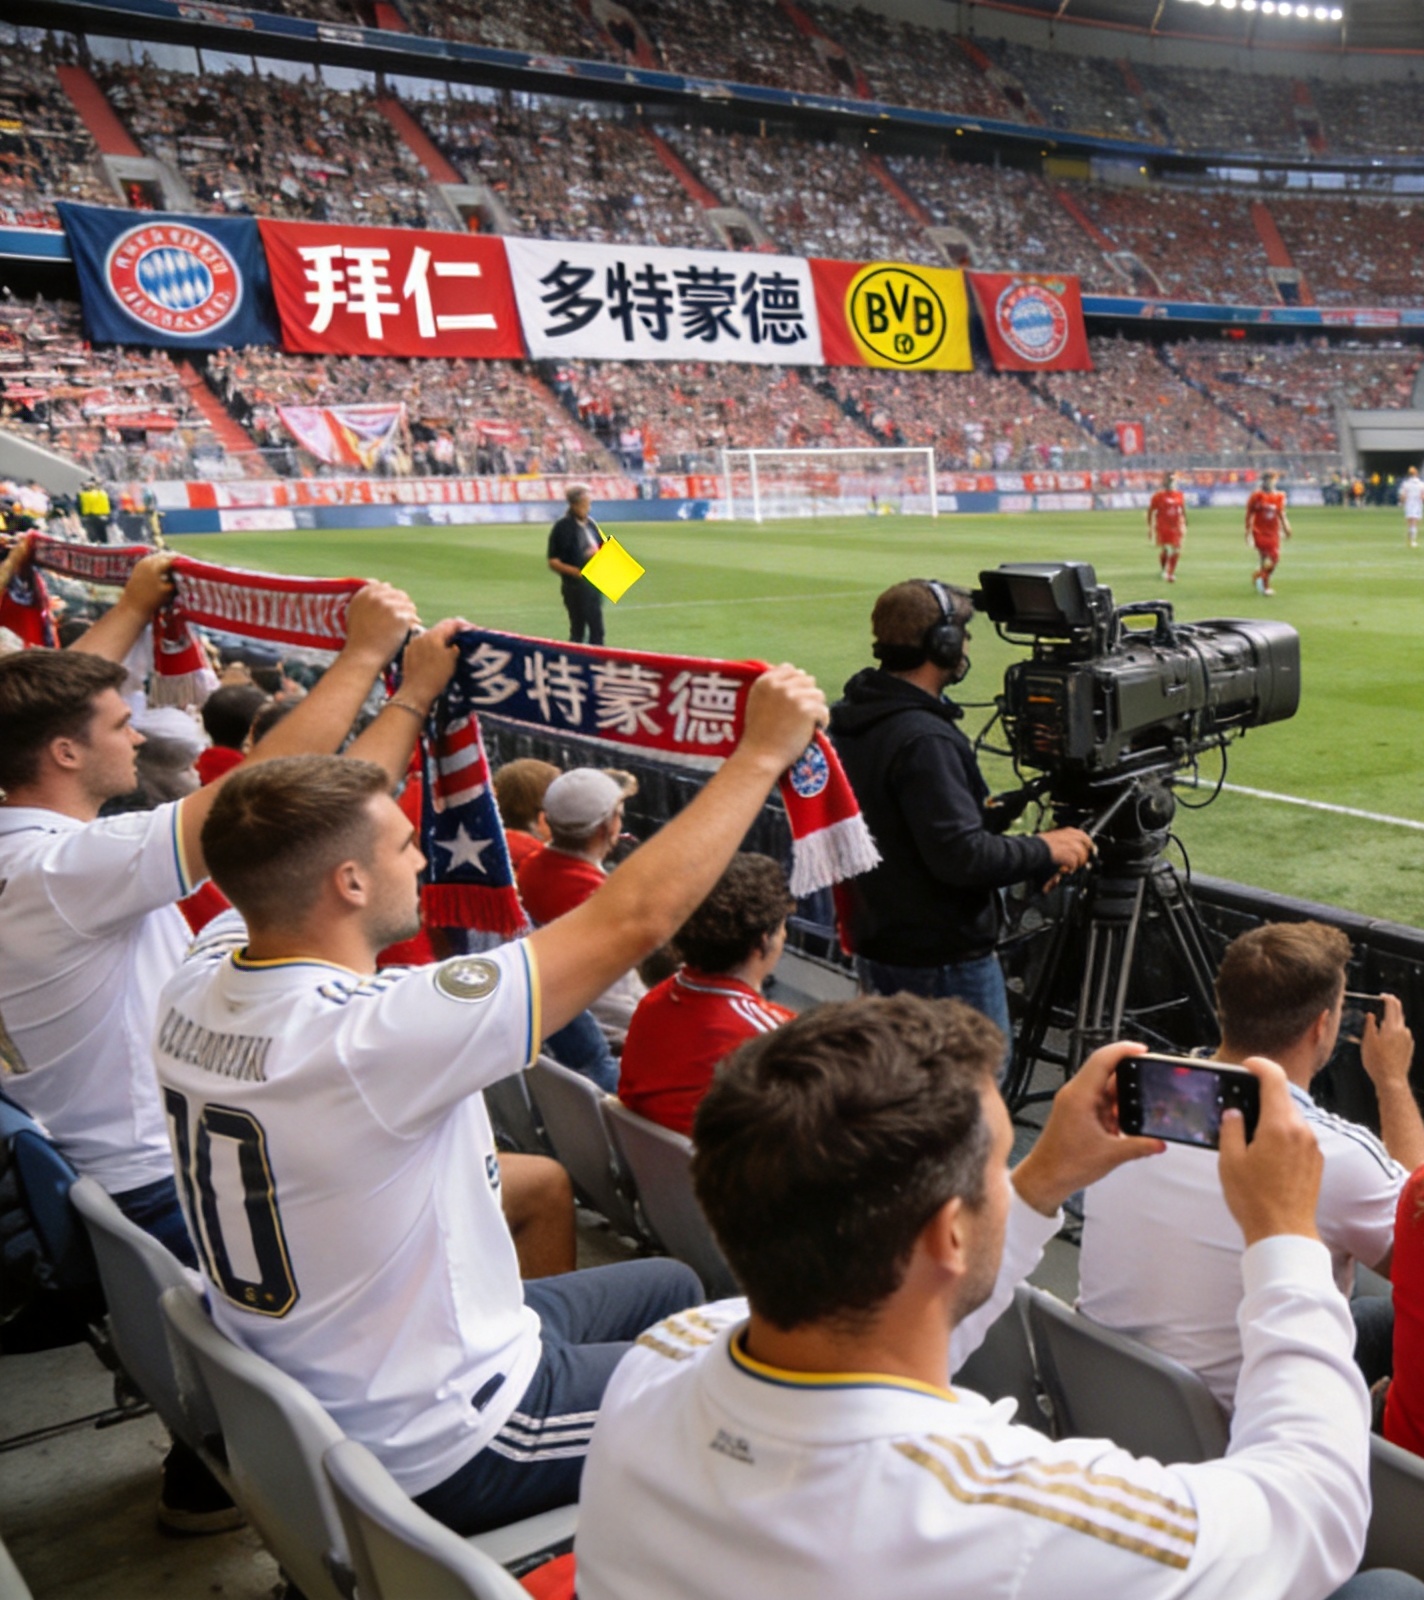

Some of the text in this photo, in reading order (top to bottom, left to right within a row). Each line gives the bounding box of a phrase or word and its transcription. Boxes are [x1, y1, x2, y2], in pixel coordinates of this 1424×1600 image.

[297, 244, 499, 340] 拜仁
[538, 259, 808, 345] 多特蒙德
[864, 279, 935, 337] BVB
[465, 642, 743, 746] 多特蒙德
[161, 1085, 301, 1319] 10
